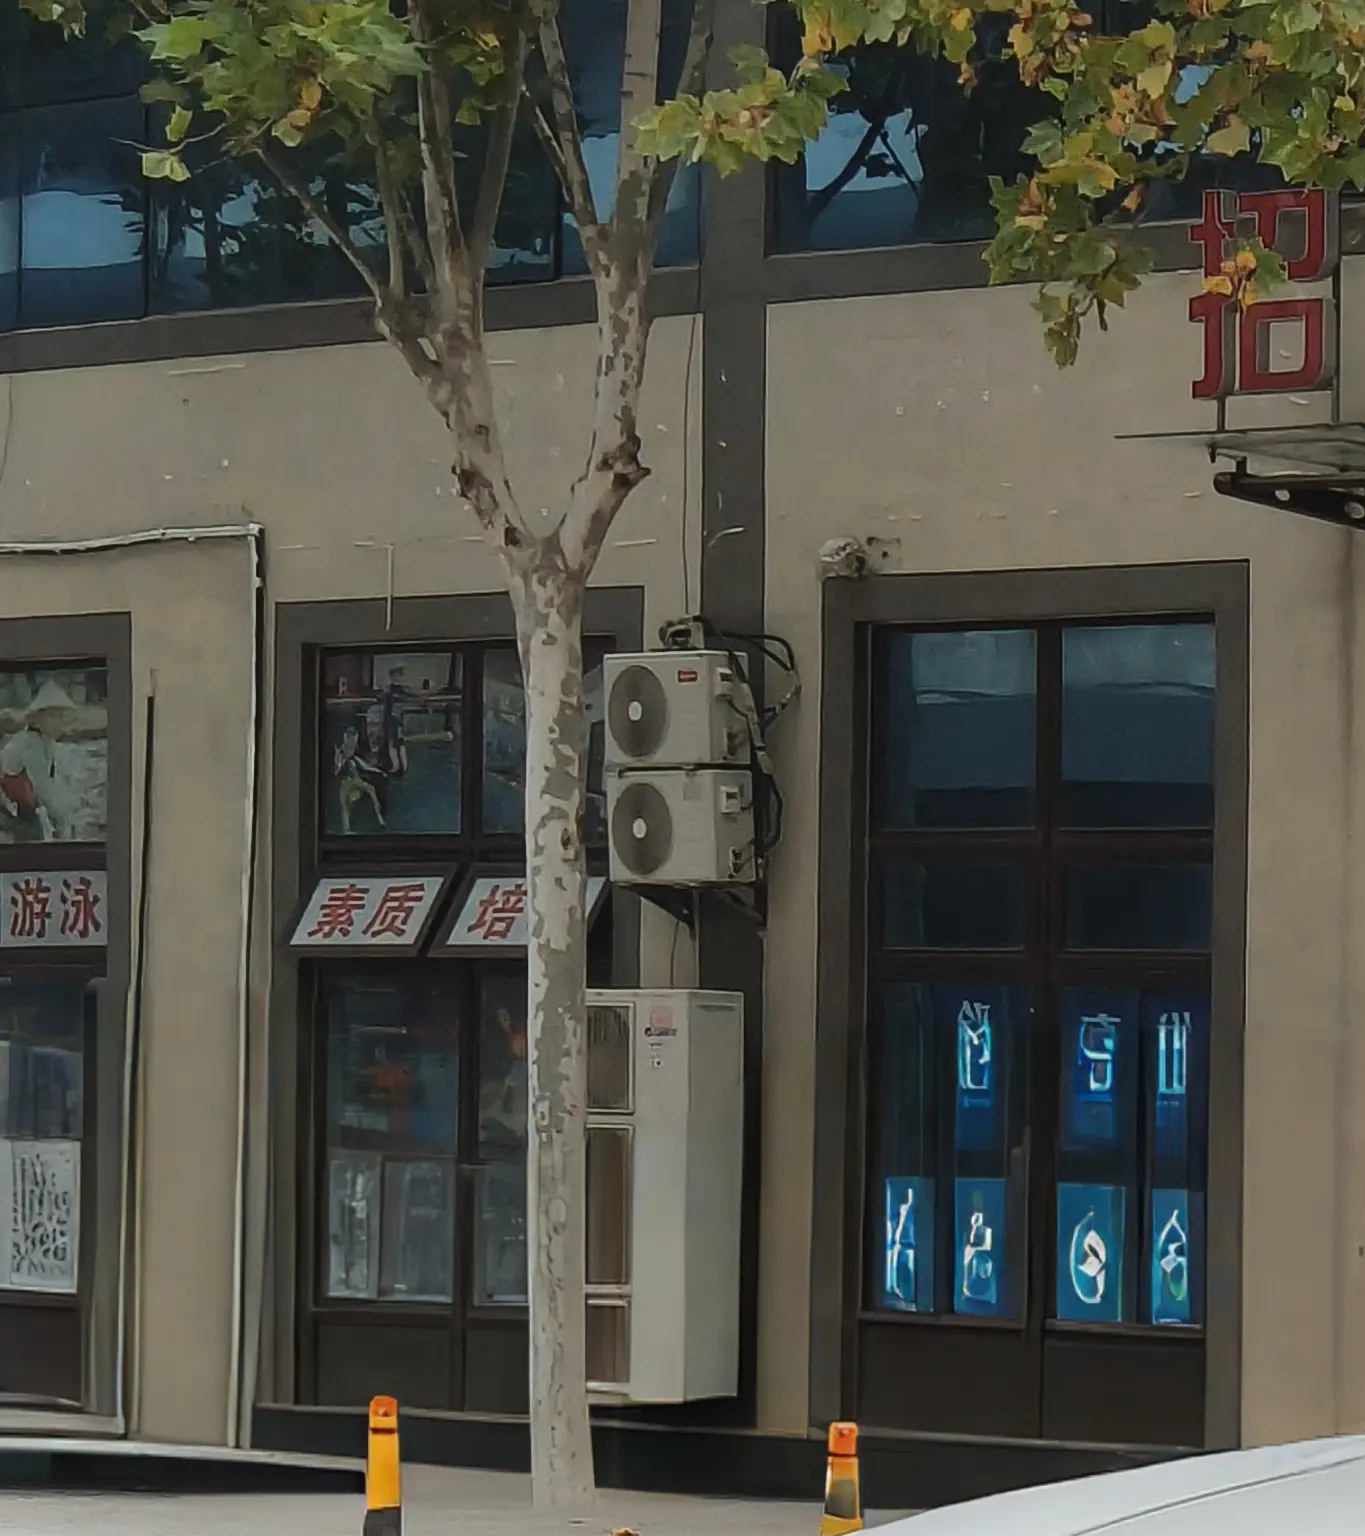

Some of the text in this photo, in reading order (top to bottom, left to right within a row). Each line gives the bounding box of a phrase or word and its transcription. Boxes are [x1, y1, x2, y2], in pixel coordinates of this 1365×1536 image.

[10, 876, 102, 938] 游泳
[307, 882, 528, 940] 素质 培
